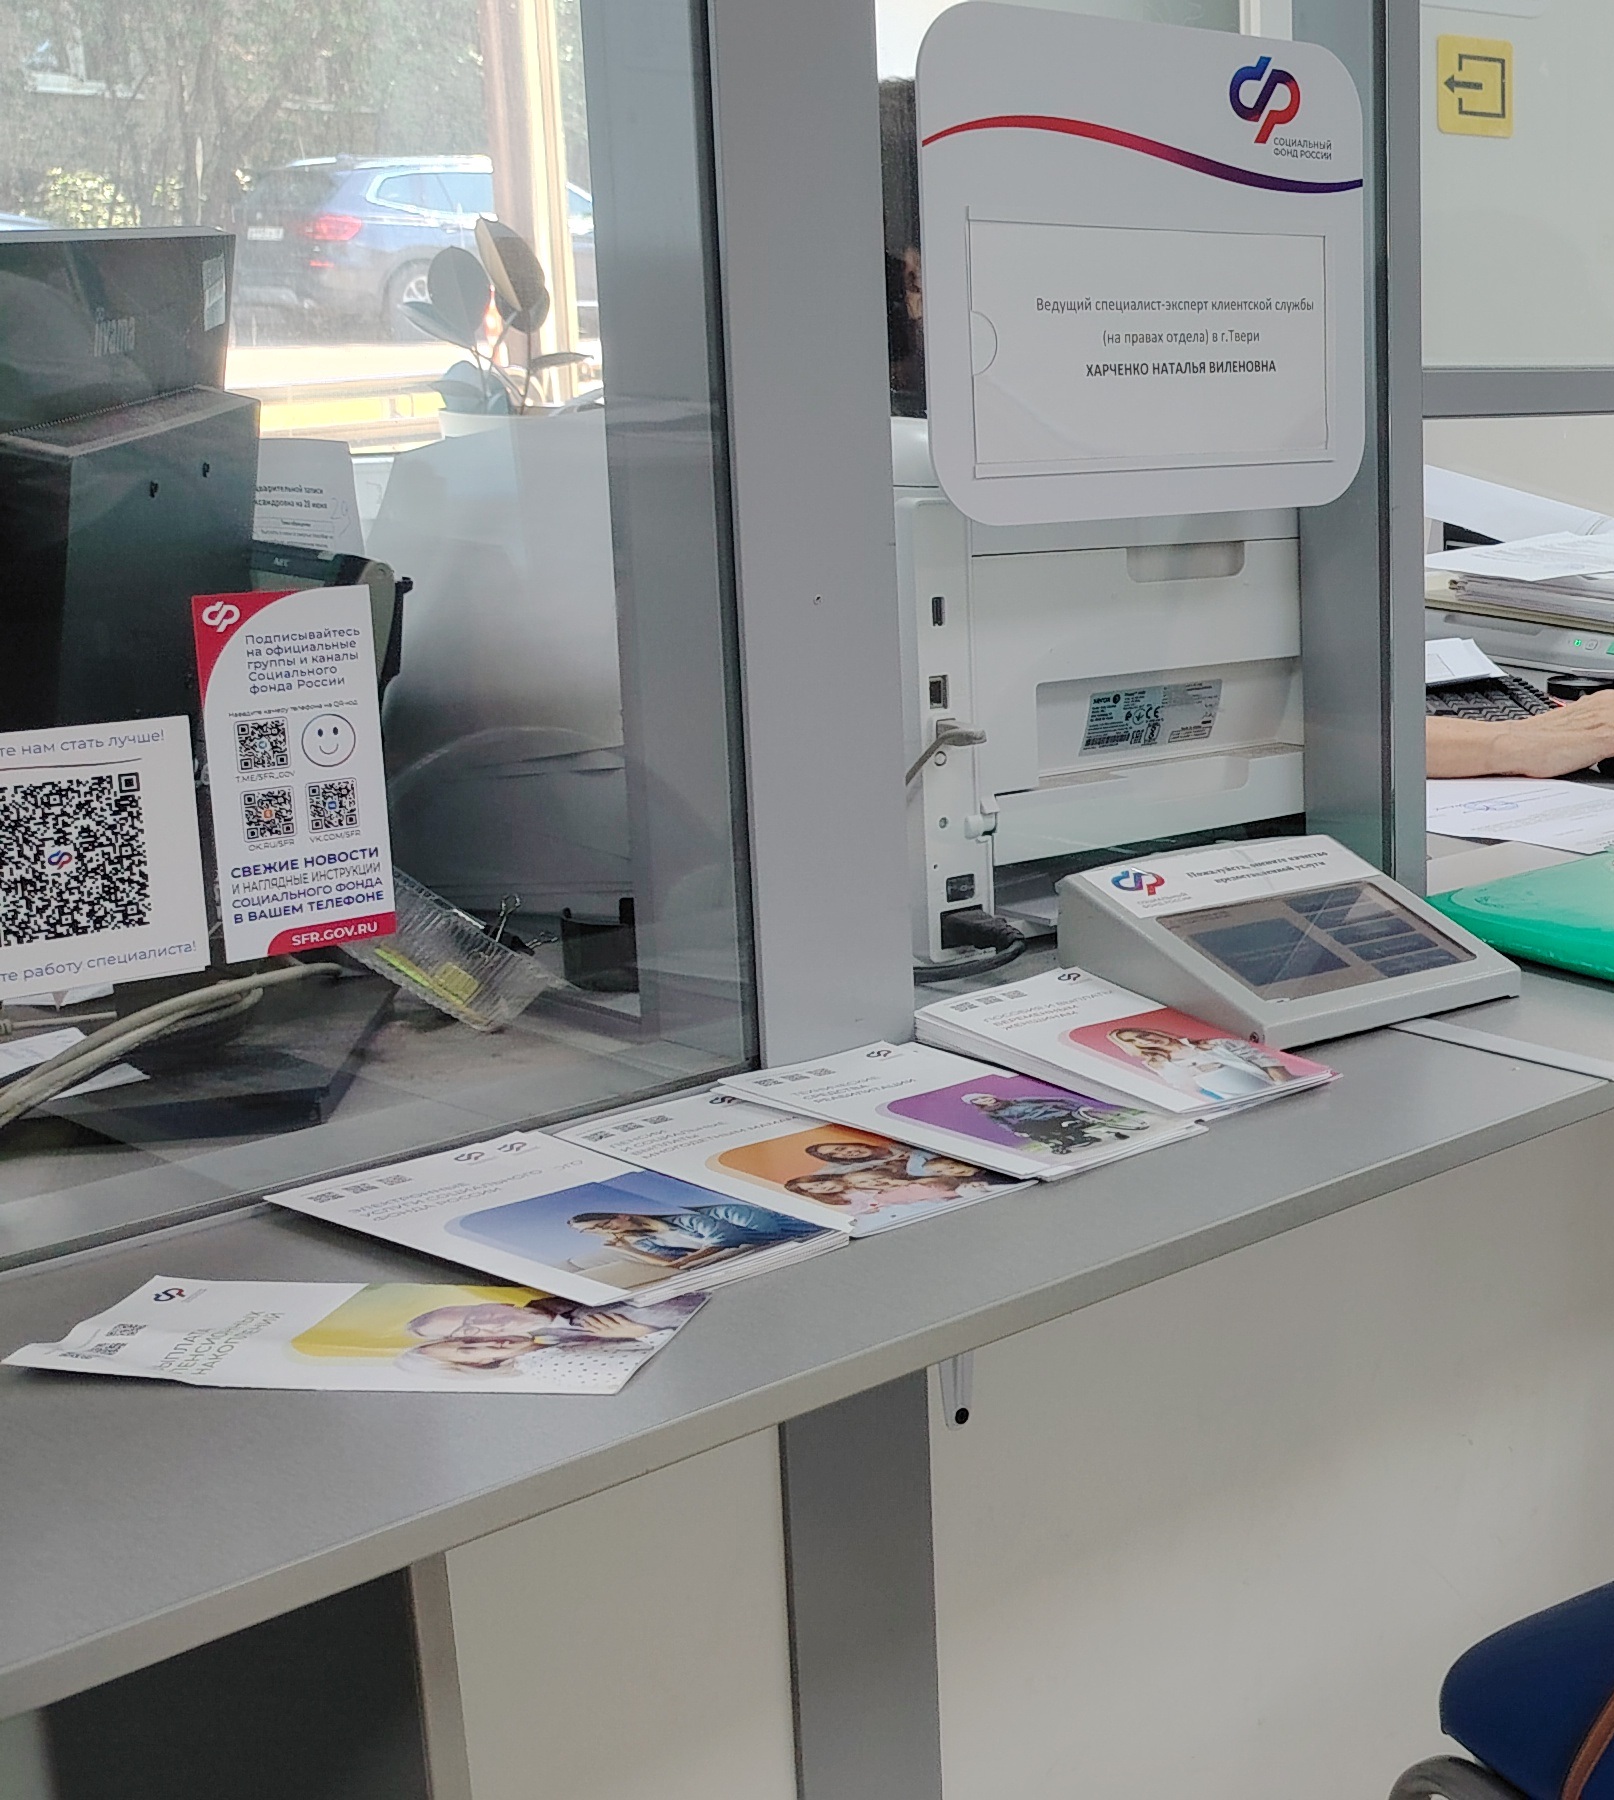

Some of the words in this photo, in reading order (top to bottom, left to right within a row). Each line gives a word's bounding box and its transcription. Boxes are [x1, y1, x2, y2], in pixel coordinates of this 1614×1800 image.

[1273, 137, 1332, 151] СОЦИАЛЬНЫЙ
[1273, 148, 1298, 159] ФОНД
[1300, 149, 1332, 161] РОССИИ
[1036, 297, 1092, 314] Ведущий
[1095, 299, 1209, 314] специалист-эксперт
[1211, 297, 1273, 311] клиентской
[1274, 298, 1315, 313] службы
[1102, 330, 1121, 347] (на
[1124, 333, 1164, 347] правах
[1166, 329, 1209, 346] отдела)
[1212, 333, 1219, 343] в
[1220, 329, 1260, 346] г.Твери
[1086, 362, 1149, 377] ХАРЧЕНКО
[1152, 361, 1206, 375] НАТАЛЬЯ
[1209, 359, 1276, 374] ВИЛЕНОВНА
[245, 627, 360, 645] Подписывайтесь
[246, 648, 262, 658] на
[265, 639, 357, 656] официальные
[247, 656, 296, 671] группы
[299, 656, 308, 665] и
[311, 651, 359, 664] каналы
[248, 665, 338, 682] Социального
[249, 681, 293, 695] фонда
[297, 676, 346, 690] России
[21, 741, 56, 755] нам
[60, 738, 104, 752] стать
[108, 729, 164, 748] лучше!
[309, 829, 361, 844] VK.COM/SFR
[230, 858, 300, 879] СВЕЖИЕ
[303, 846, 379, 868] НОВОСТИ
[231, 883, 241, 895] И
[242, 871, 310, 893] НАГЛЯДНЫЕ
[311, 861, 382, 882] ИНСТРУКЦИИ
[231, 884, 333, 909] СОЦИАЛЬНОГО
[335, 876, 383, 893] ФОНДА
[233, 913, 244, 925] В
[248, 903, 304, 922] ВАШЕМ
[307, 890, 384, 912] ТЕЛЕФОНЕ
[291, 921, 378, 946] SFR.GOV.RU
[23, 958, 82, 981] работу
[87, 940, 197, 970] специалиста!
